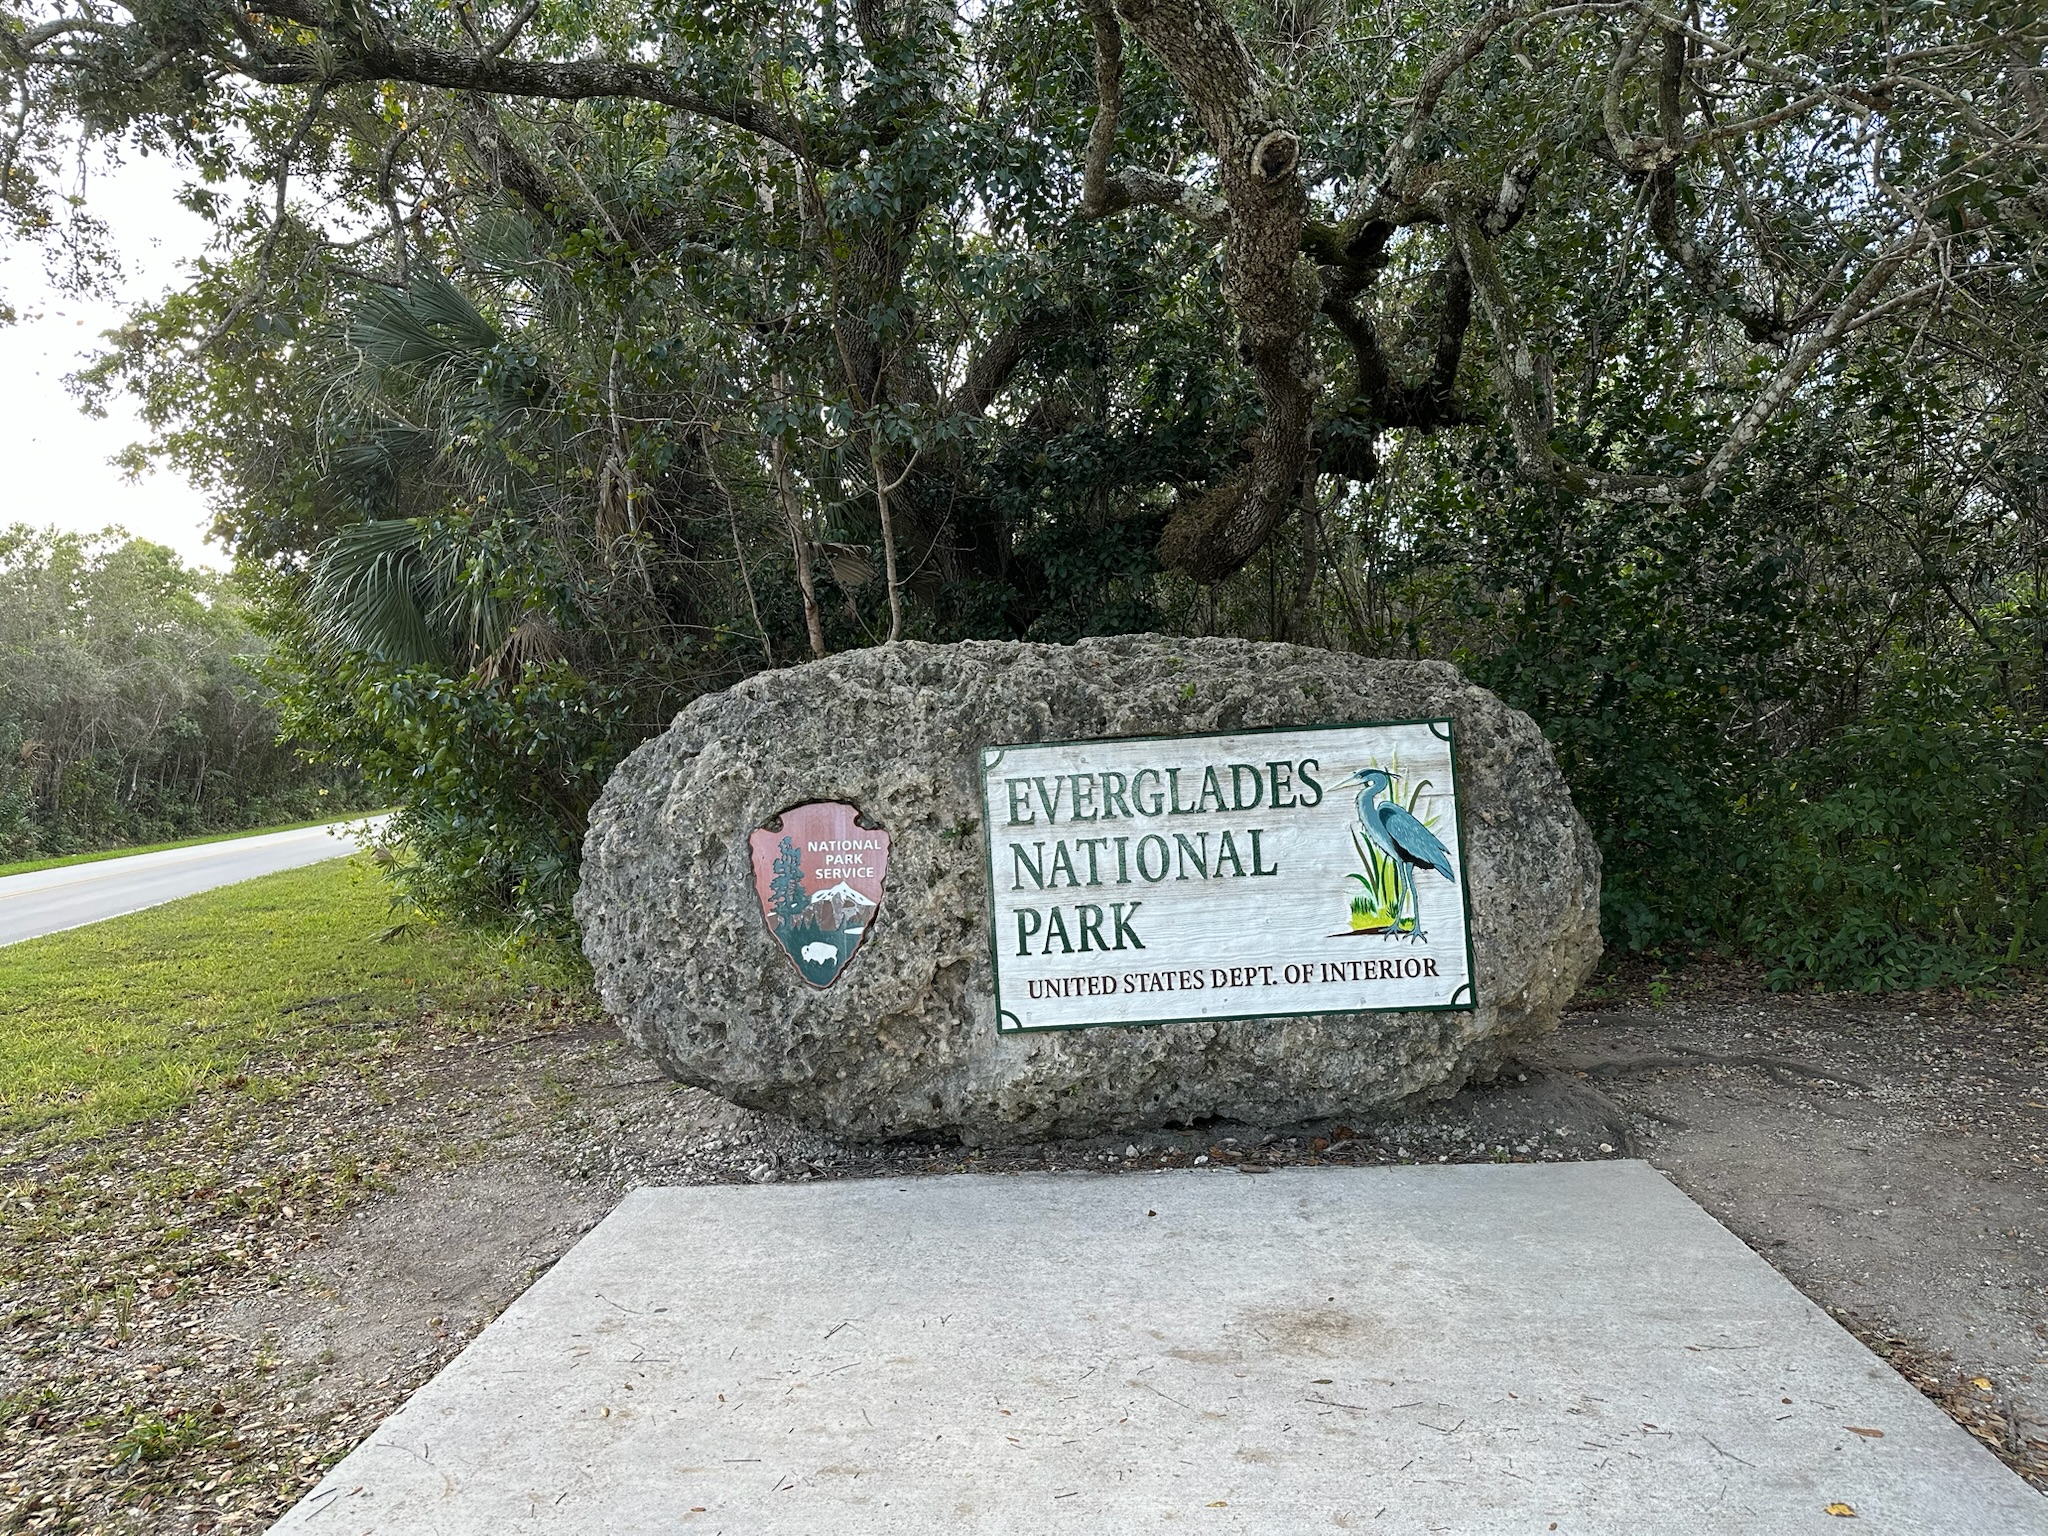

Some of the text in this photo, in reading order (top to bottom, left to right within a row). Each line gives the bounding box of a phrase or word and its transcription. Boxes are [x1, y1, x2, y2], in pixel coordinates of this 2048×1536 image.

[1006, 759, 1323, 825] EVERGLADES
[808, 840, 882, 852] NATIONAL
[825, 854, 863, 865] PARK
[1010, 829, 1278, 890] NATIONAL
[815, 867, 874, 879] SERVICE
[1013, 901, 1146, 956] PARK
[1028, 958, 1440, 999] UNITED STATES DEPT. OF INTERIOR
